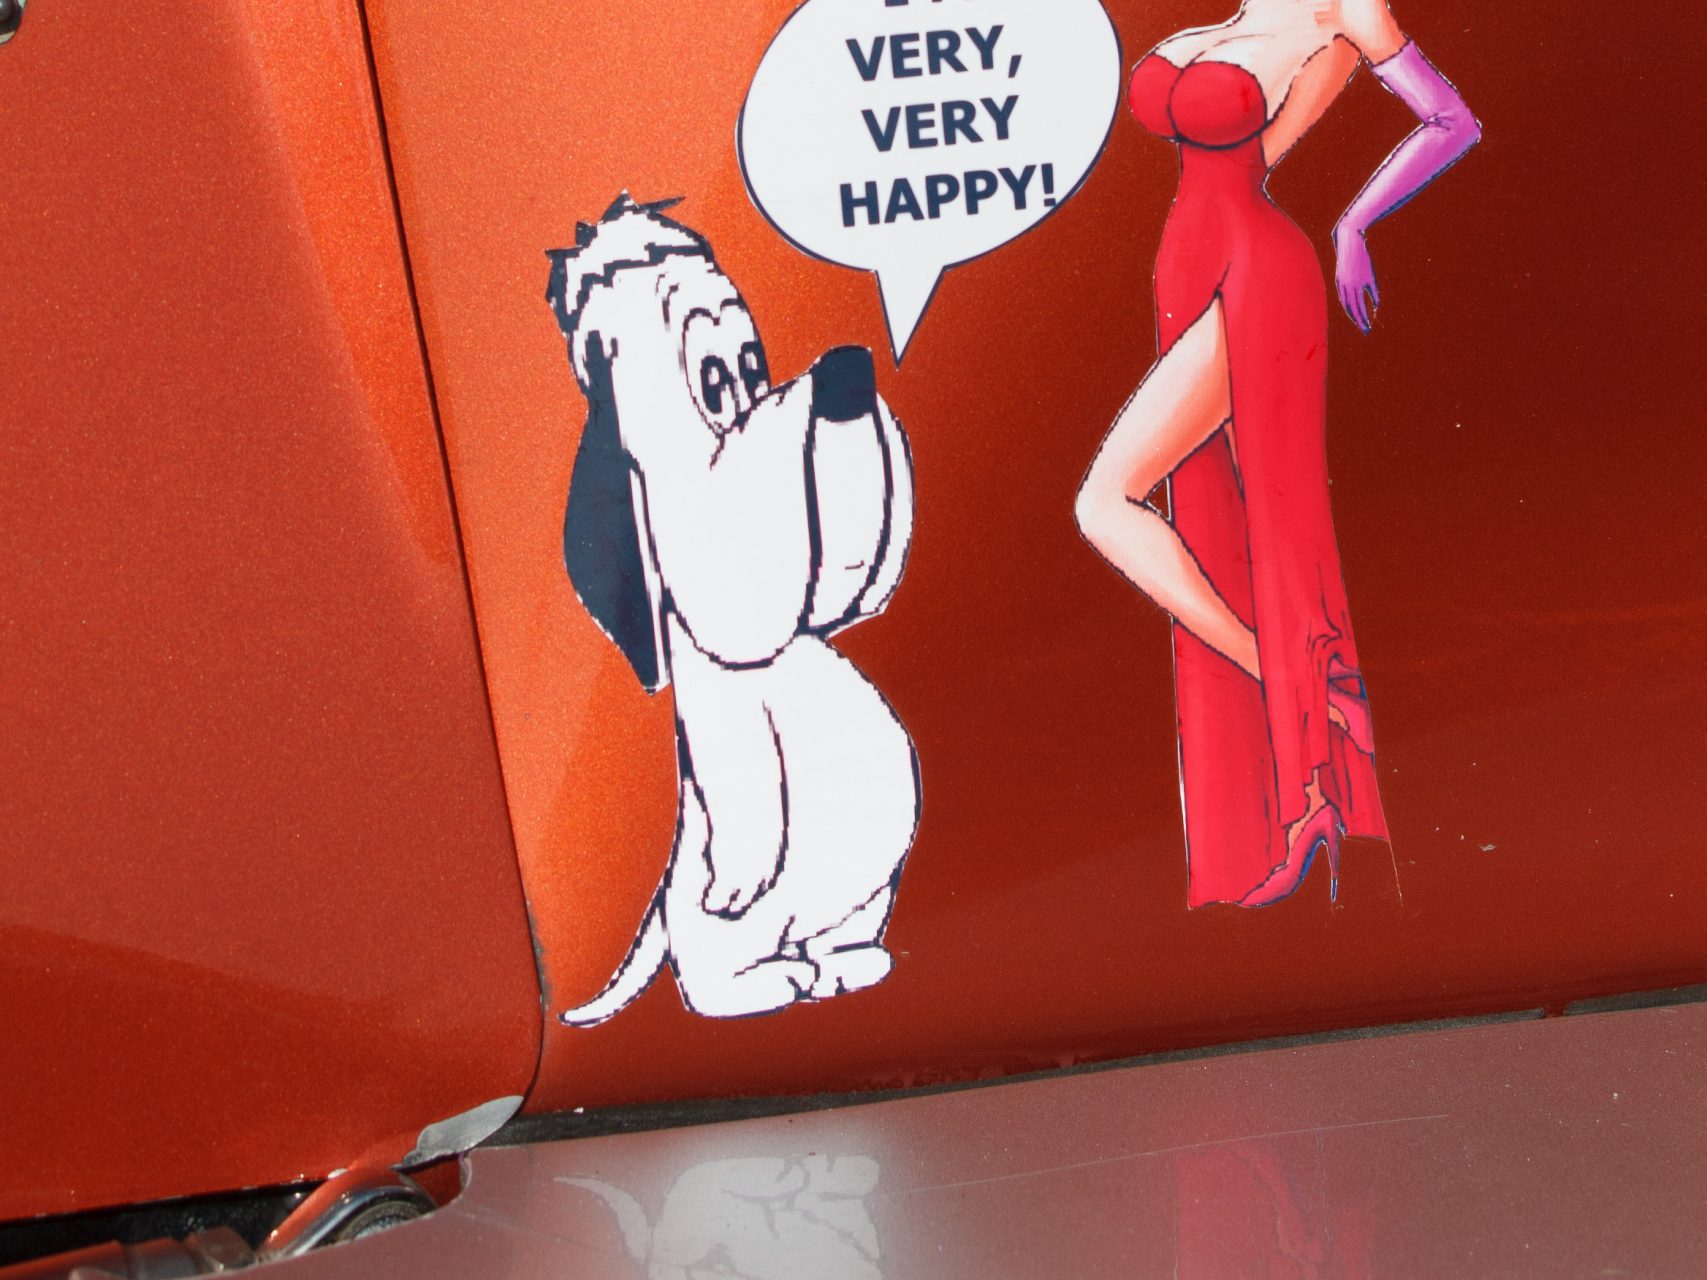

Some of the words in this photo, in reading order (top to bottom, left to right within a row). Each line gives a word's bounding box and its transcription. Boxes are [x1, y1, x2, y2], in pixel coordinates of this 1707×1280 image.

[845, 24, 1023, 82] VERY,
[861, 94, 1020, 152] VERY
[839, 162, 1058, 228] HAPPY!
